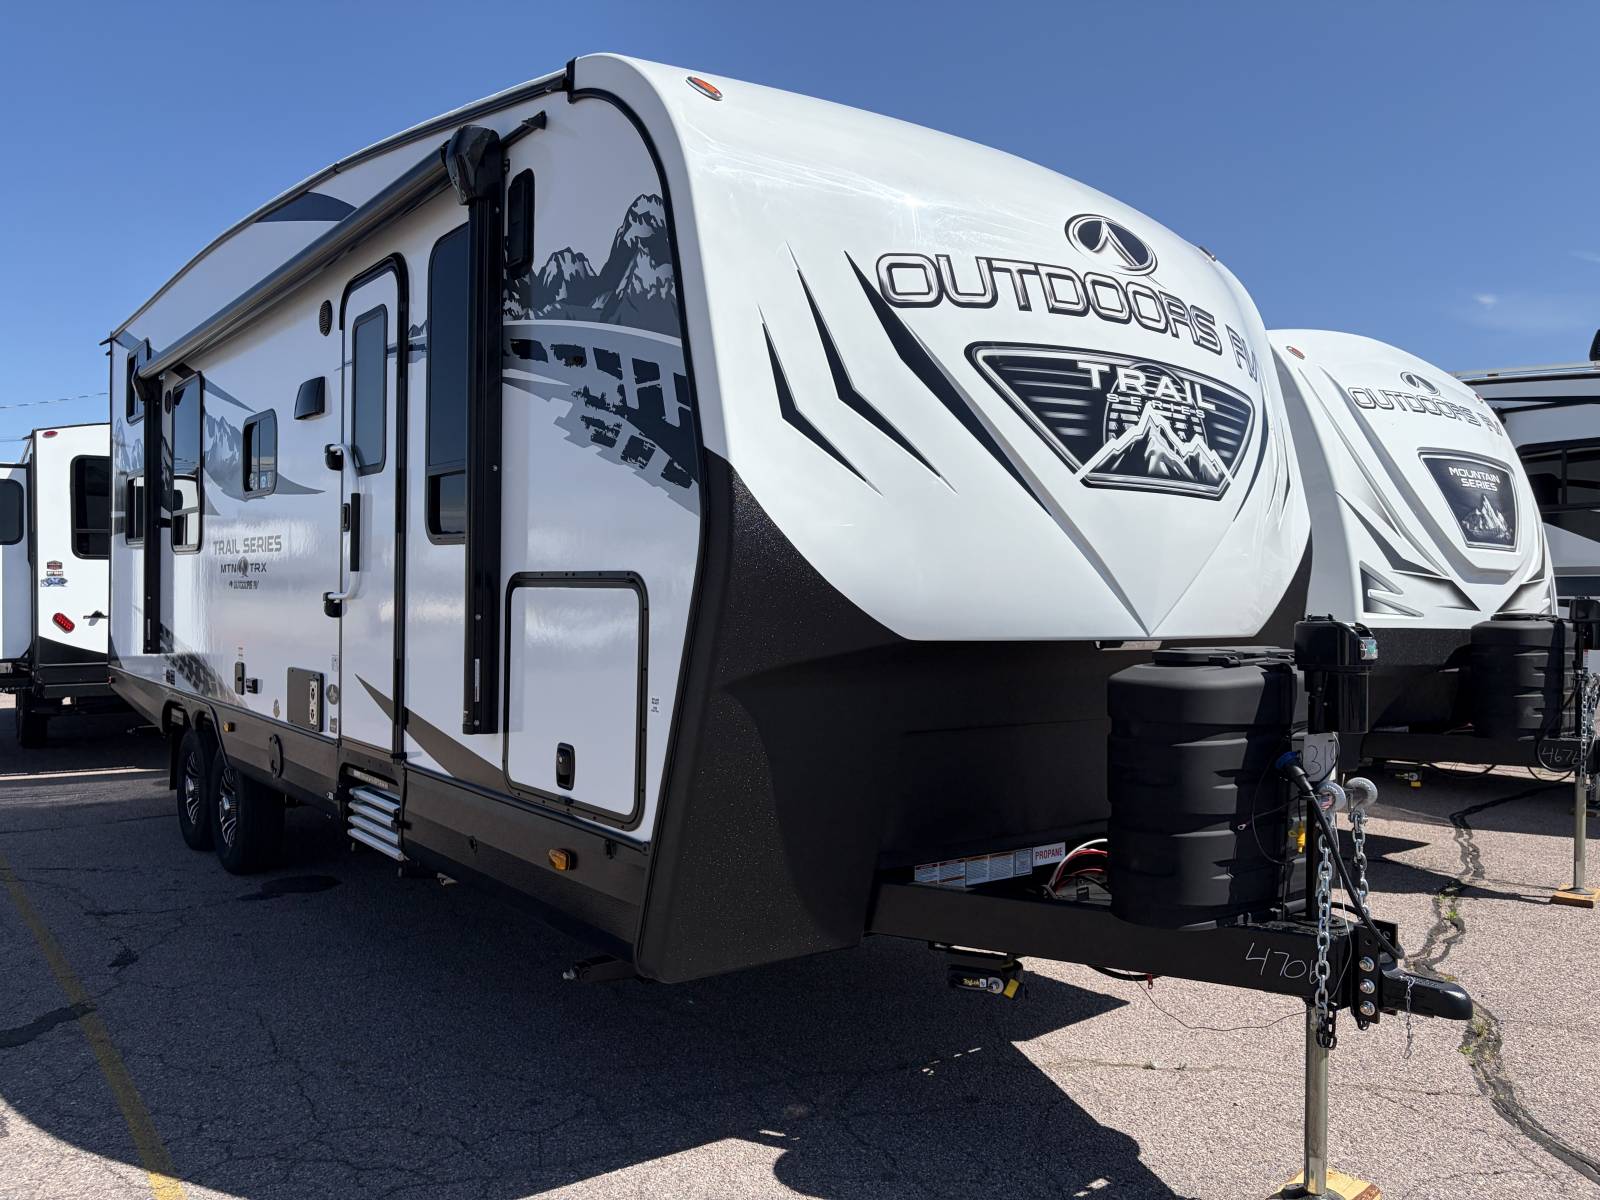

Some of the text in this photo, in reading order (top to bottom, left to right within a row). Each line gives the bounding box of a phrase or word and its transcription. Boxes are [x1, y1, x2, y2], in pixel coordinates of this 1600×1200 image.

[876, 253, 1258, 383] OUTDOORS RV
[1077, 360, 1216, 411] TRAIL
[1106, 392, 1206, 419] SERIES
[1347, 386, 1481, 427] OUTDOORS
[1448, 466, 1501, 484] MOUNTAIN
[1461, 478, 1499, 493] SERIES
[213, 535, 282, 555] TRAIL SERIES
[220, 562, 267, 574] MTN TRX
[1034, 846, 1063, 861] PROPANE
